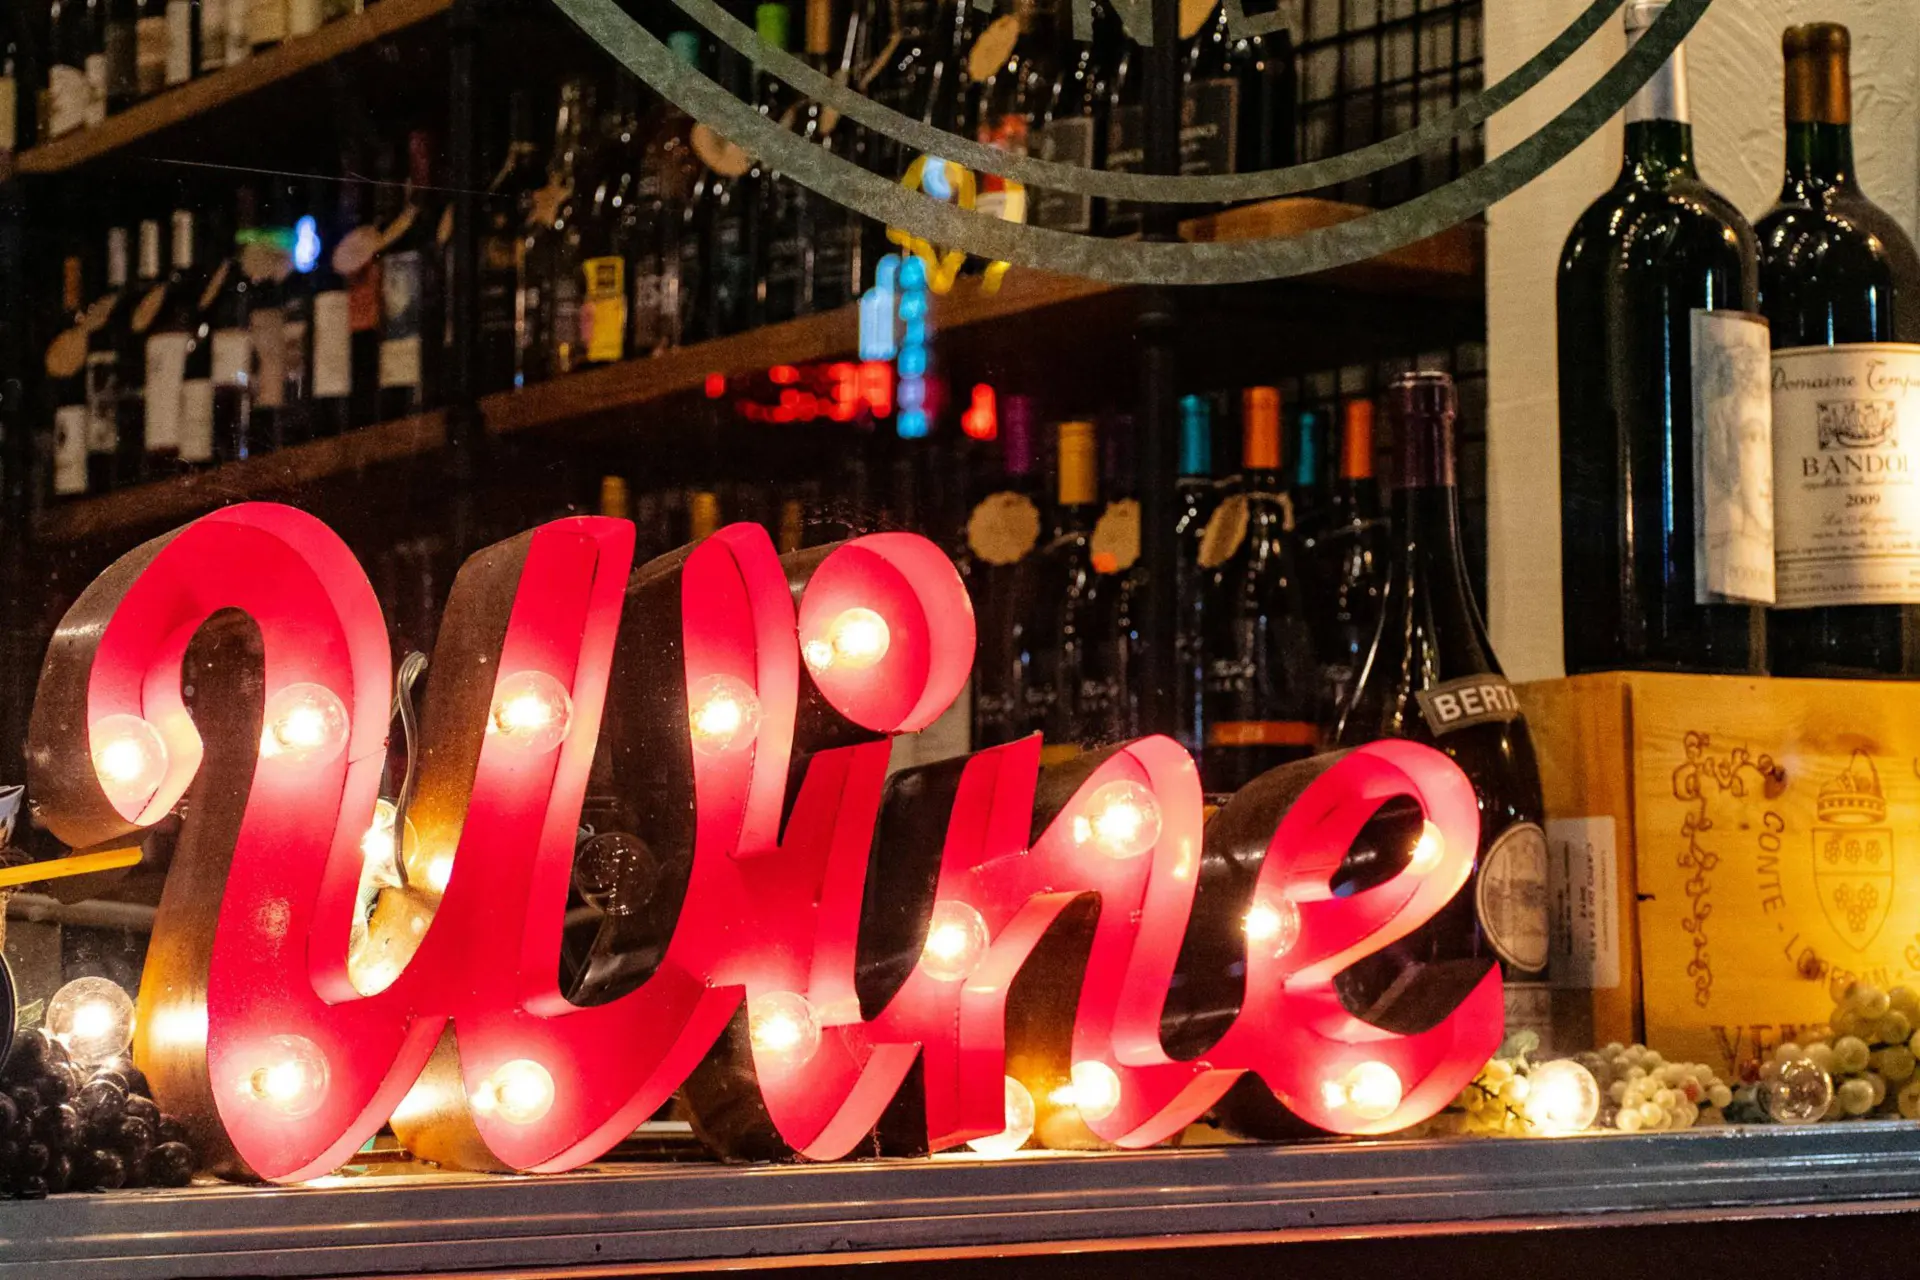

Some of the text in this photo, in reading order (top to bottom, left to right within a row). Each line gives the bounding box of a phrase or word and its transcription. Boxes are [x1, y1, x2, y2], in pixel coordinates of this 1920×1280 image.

[1771, 365, 1856, 391] Domaine
[1845, 493, 1881, 509] 2009
[26, 501, 1504, 1183] Wine
[1756, 811, 1785, 914] CONTE
